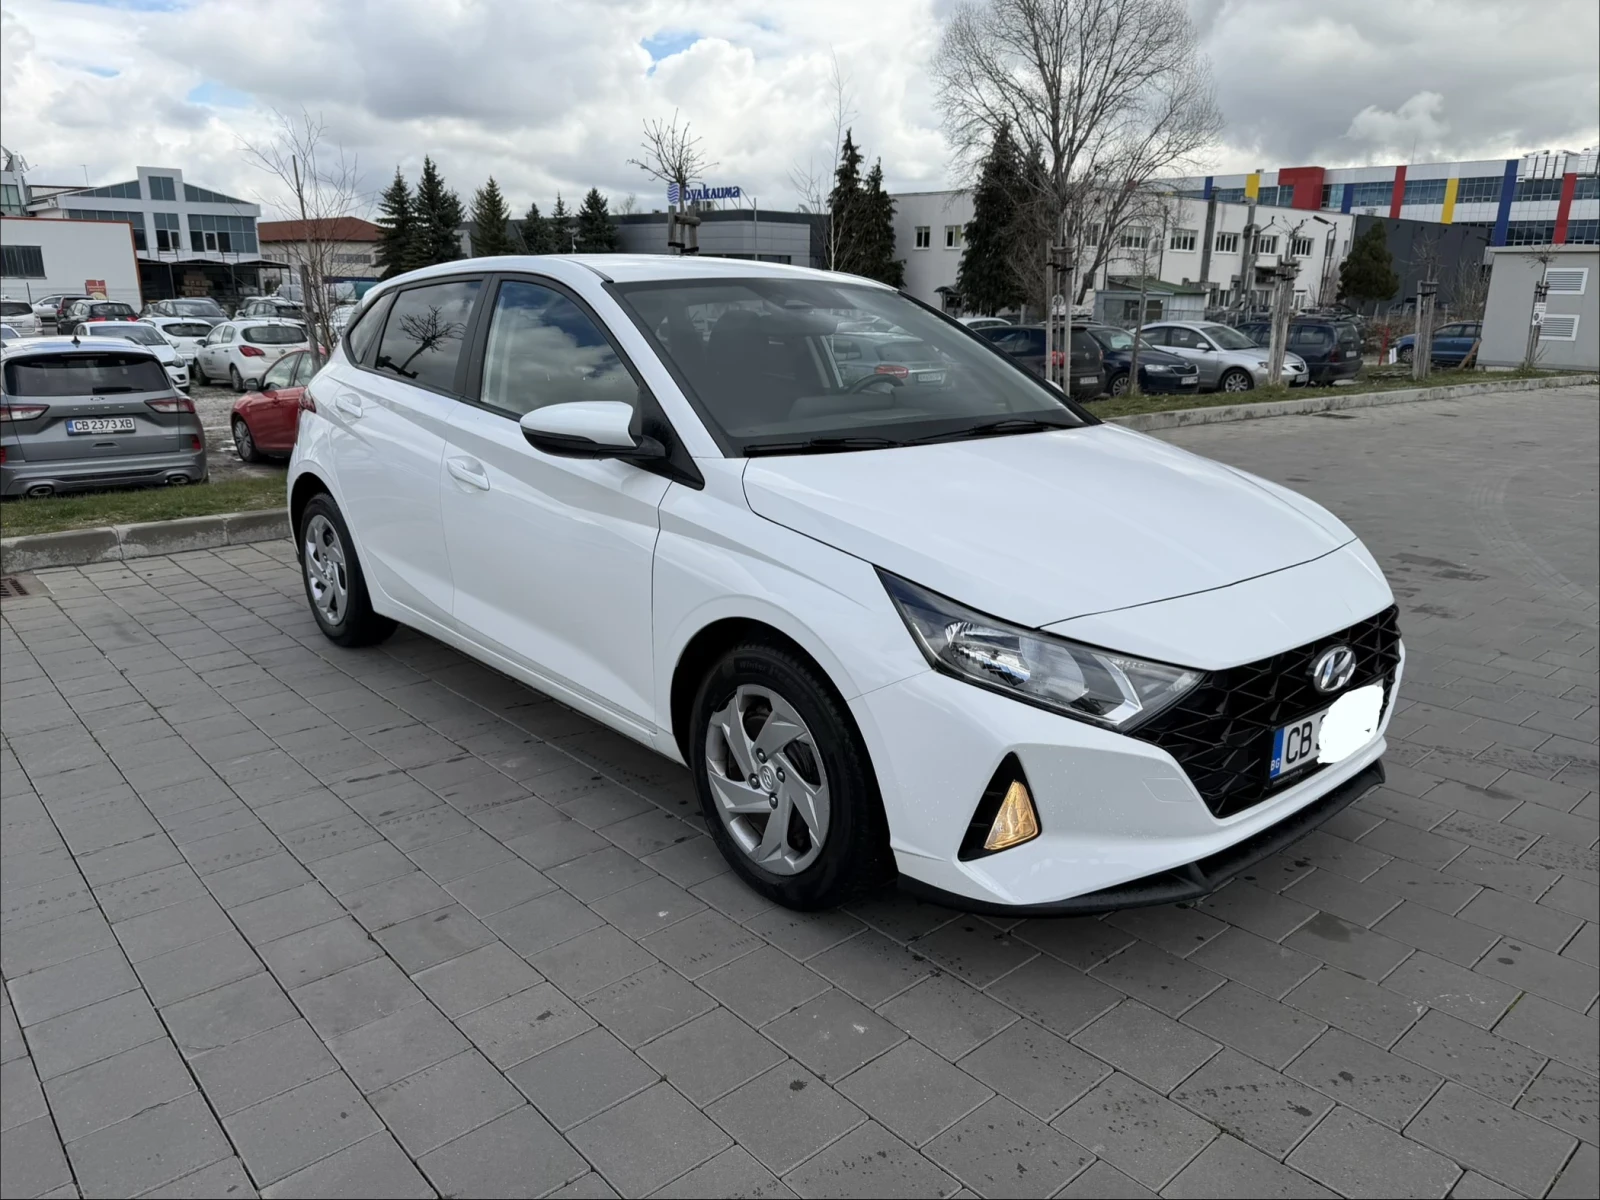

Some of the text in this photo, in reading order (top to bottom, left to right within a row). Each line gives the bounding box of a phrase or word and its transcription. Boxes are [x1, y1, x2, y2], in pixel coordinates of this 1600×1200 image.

[74, 418, 133, 431] CB 2373 XB
[1286, 720, 1313, 764] CB
[1270, 757, 1281, 771] BG
